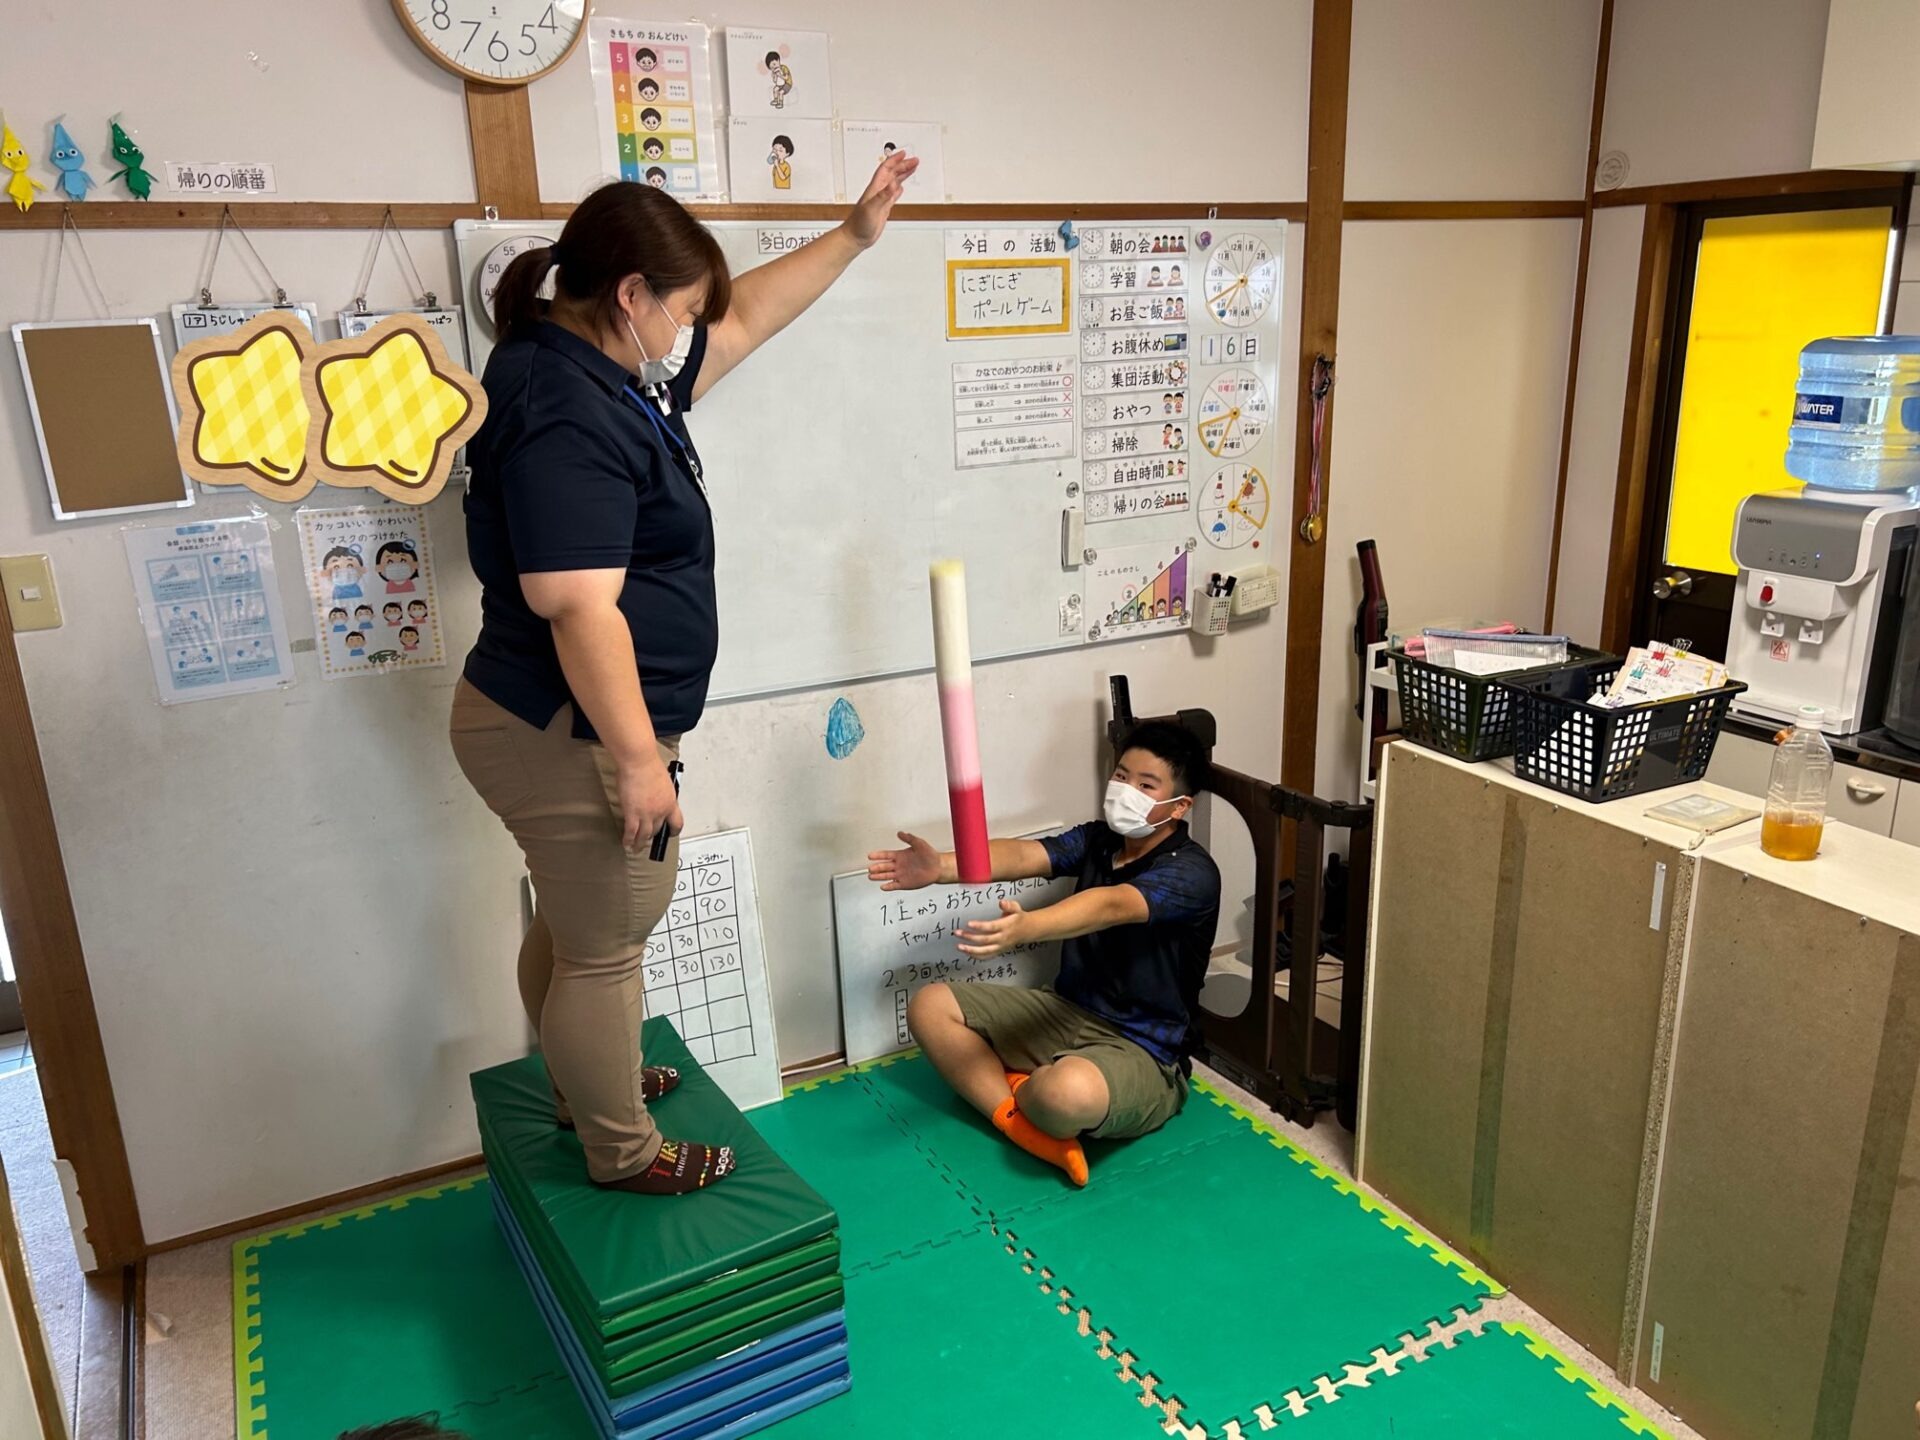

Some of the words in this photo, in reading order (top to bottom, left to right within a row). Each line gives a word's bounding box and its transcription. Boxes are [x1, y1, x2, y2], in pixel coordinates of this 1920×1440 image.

[432, 0, 450, 30] 8
[538, 3, 558, 34] 4
[460, 20, 482, 53] 7
[518, 24, 537, 56] 5
[610, 29, 634, 39] きもち
[637, 31, 645, 39] の
[648, 31, 688, 42] おんどけい
[487, 30, 509, 62] 6
[616, 53, 624, 64] 5
[618, 84, 626, 94] 4
[622, 113, 629, 124] 3
[624, 144, 631, 153] 2
[177, 172, 265, 190] 帰りの順番
[760, 234, 816, 250] 今日のお
[962, 238, 987, 254] 今日
[1003, 240, 1016, 252] の
[1030, 238, 1056, 253] 活動
[1109, 238, 1151, 254] 朝の会
[503, 246, 516, 257] 55
[488, 264, 500, 274] 50
[962, 272, 1021, 294] にぎにぎ
[1110, 271, 1136, 289] 学習
[427, 315, 452, 325] っぱつ
[1110, 304, 1164, 321] お昼ご飯
[1111, 337, 1164, 355] お腹休め
[1111, 369, 1164, 388] 集団活動
[1112, 403, 1152, 420] おやつ
[1801, 402, 1835, 416] WATER
[1112, 436, 1138, 453] 掃除
[1114, 464, 1164, 484] 自由時間
[1113, 494, 1165, 514] 帰りの会
[327, 531, 409, 545] マスクのつけかた
[698, 868, 721, 888] 70
[671, 908, 691, 925] 50
[700, 896, 726, 916] 90
[646, 941, 666, 959] 50
[675, 934, 693, 949] 30
[703, 927, 734, 940] 110
[649, 968, 665, 983] 50
[677, 959, 699, 975] 30
[709, 952, 735, 971] 130
